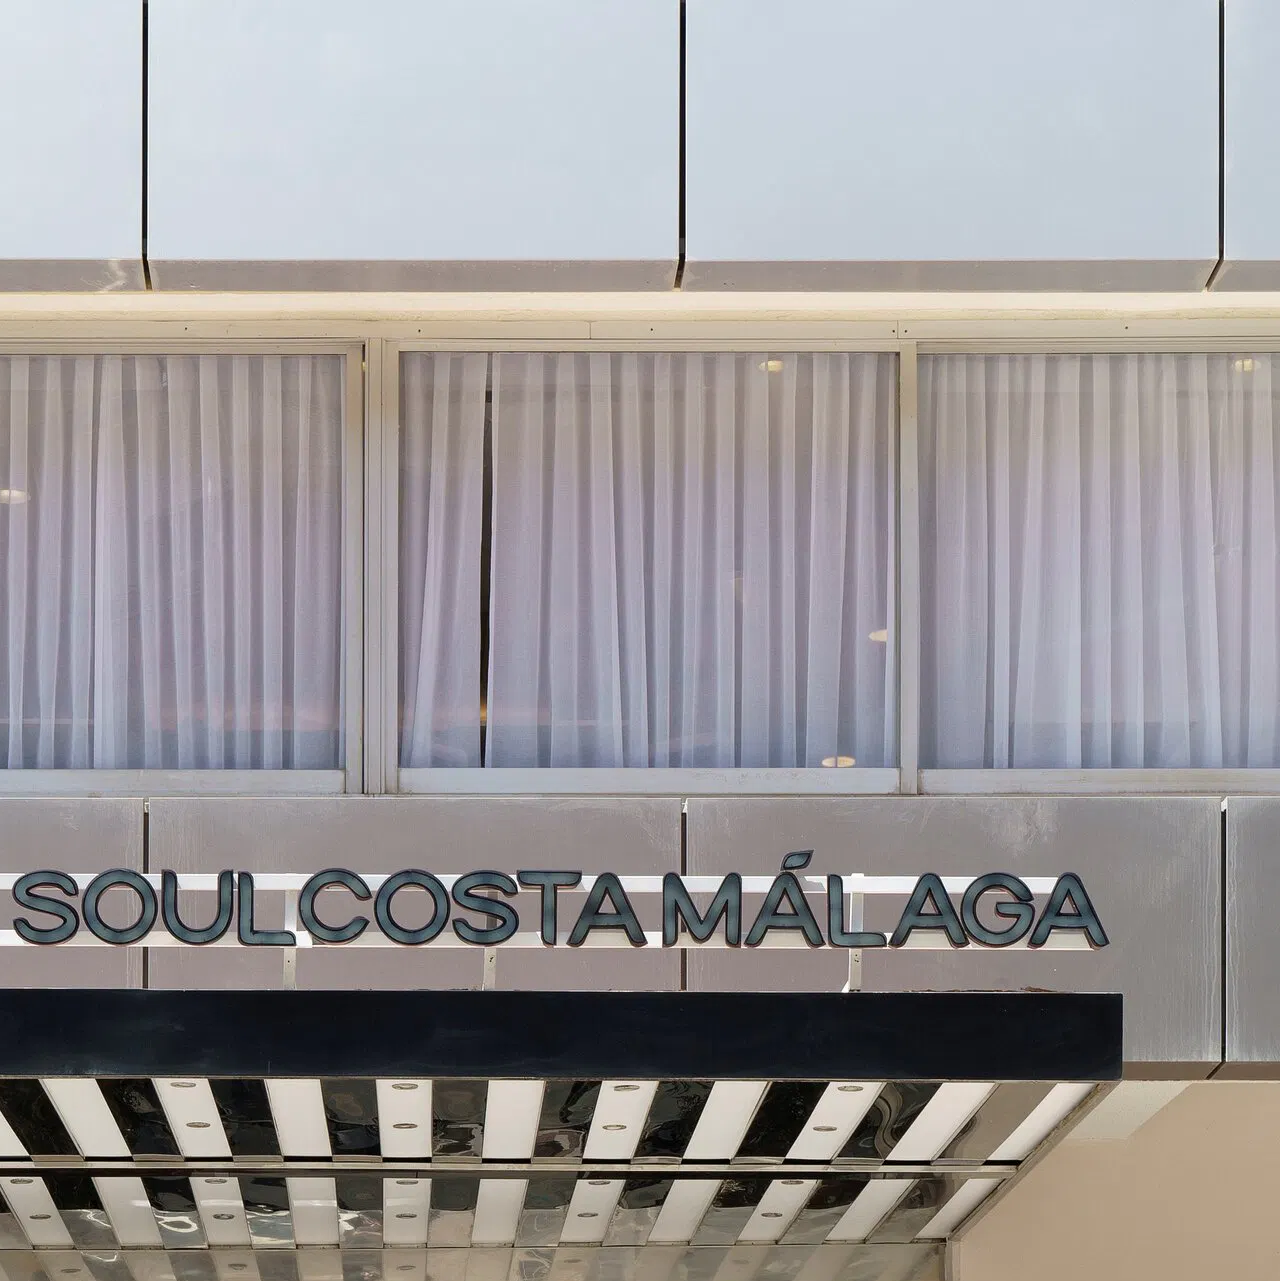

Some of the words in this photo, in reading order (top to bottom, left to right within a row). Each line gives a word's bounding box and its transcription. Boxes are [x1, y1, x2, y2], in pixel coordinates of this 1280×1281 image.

[12, 867, 297, 949] SOUL
[296, 866, 649, 948] COSTA
[662, 849, 1110, 950] MÁLAGA
